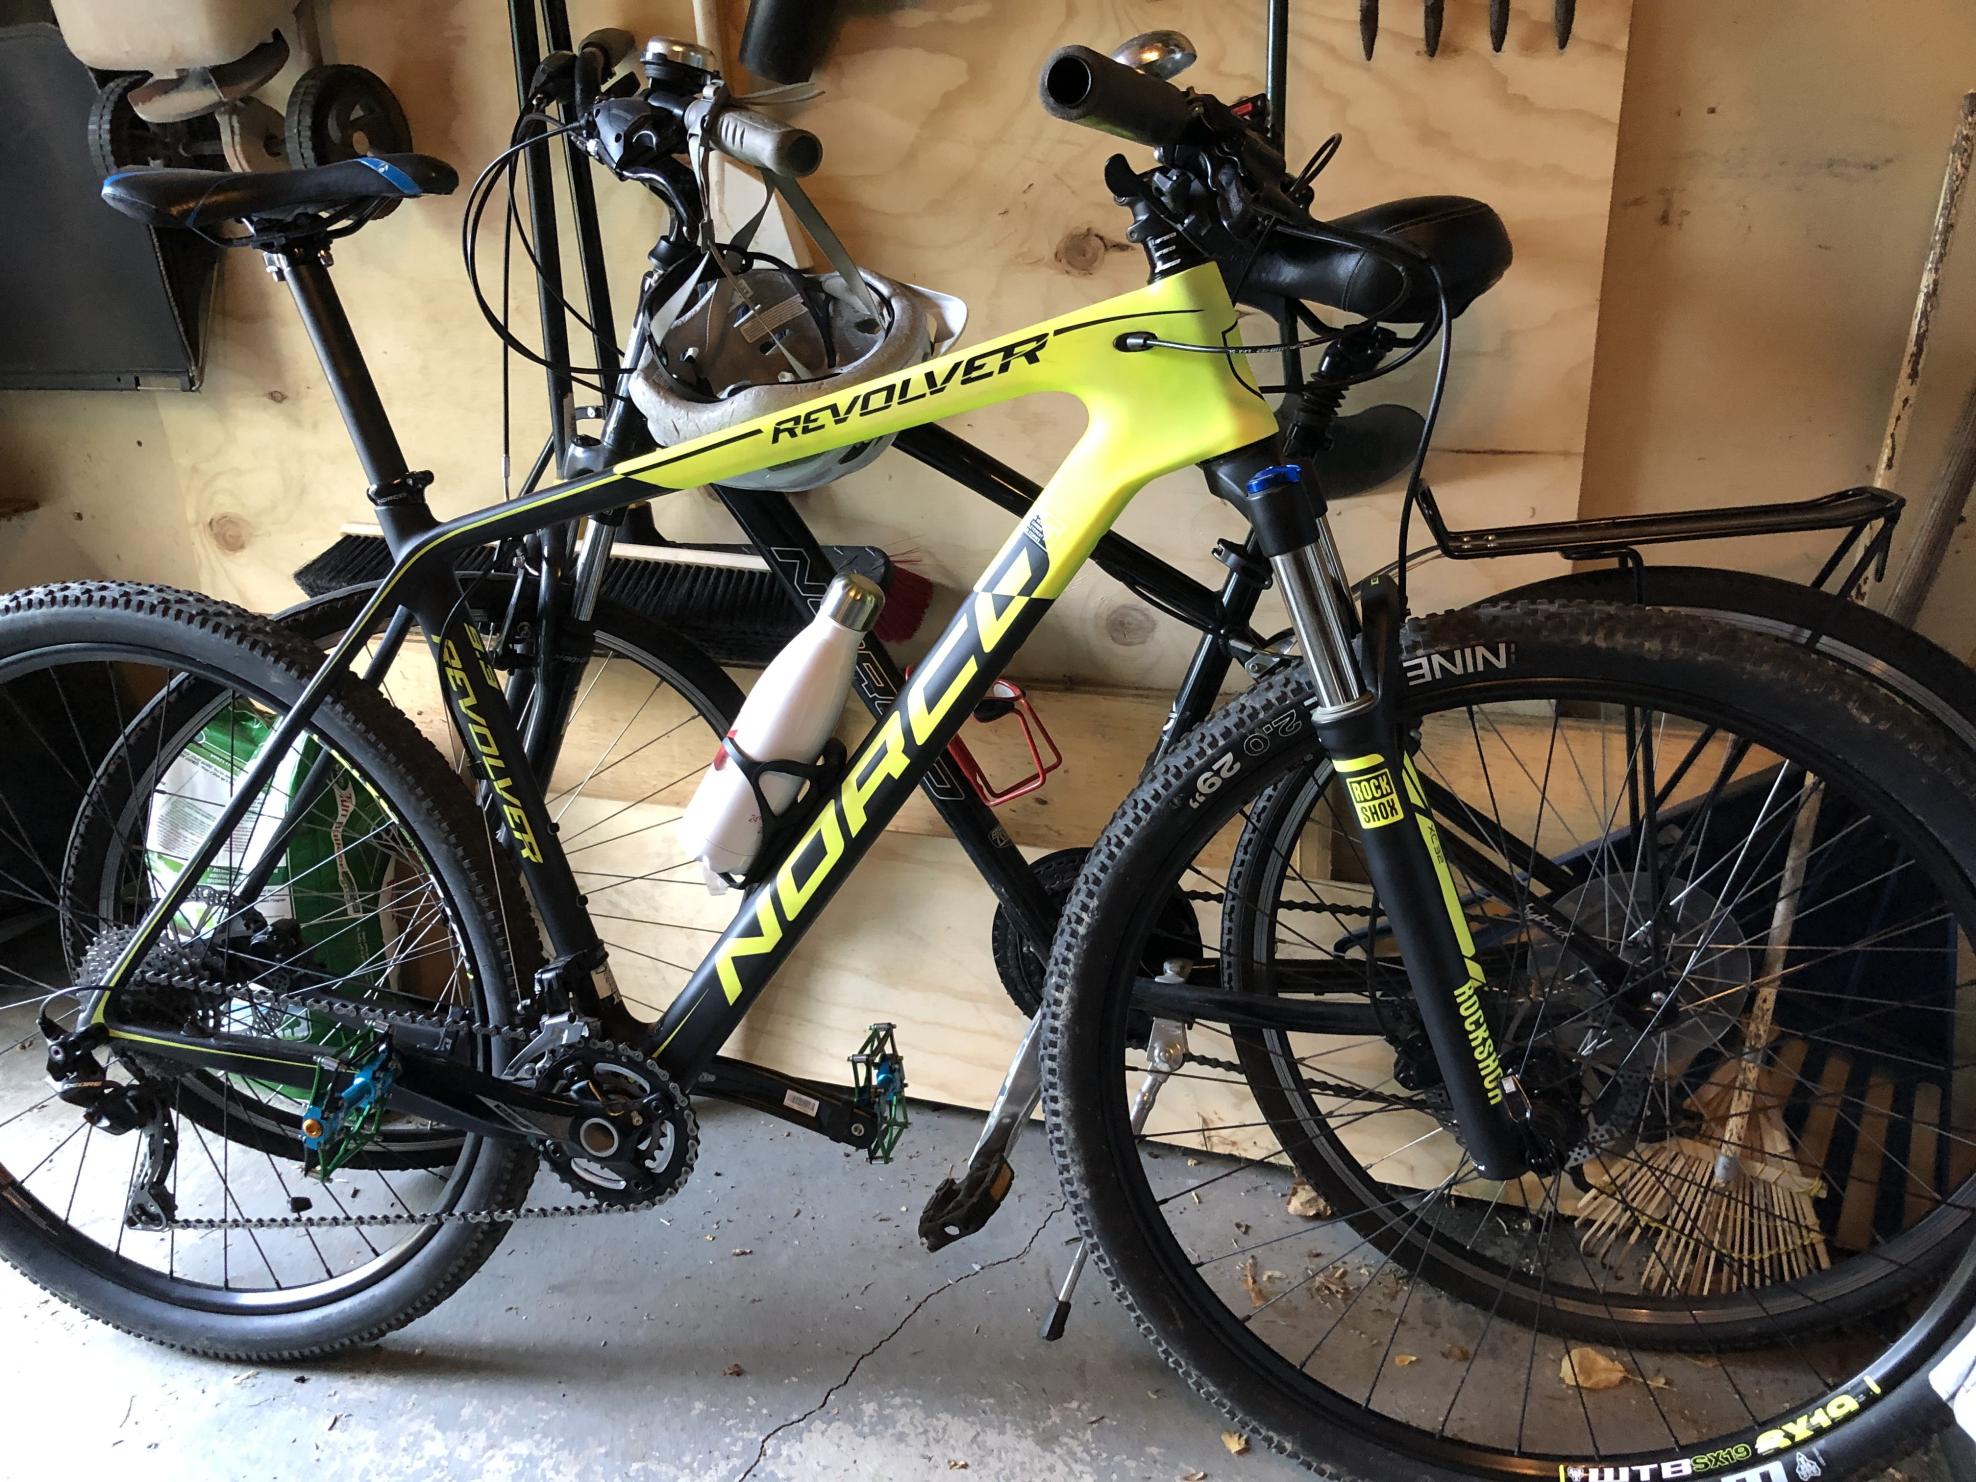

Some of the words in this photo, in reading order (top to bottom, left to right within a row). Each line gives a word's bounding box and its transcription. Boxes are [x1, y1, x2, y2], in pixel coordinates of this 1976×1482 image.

[772, 332, 1050, 444] REVOLVER
[1402, 642, 1507, 686] NINE
[431, 634, 544, 864] REVOLVER
[1244, 709, 1302, 756] 2.0
[715, 533, 1050, 1006] NORCO
[1351, 774, 1392, 802] ROCK
[1361, 797, 1399, 824] SHOX
[1589, 1459, 1692, 1482] WTB
[1690, 1444, 1752, 1473] SX19
